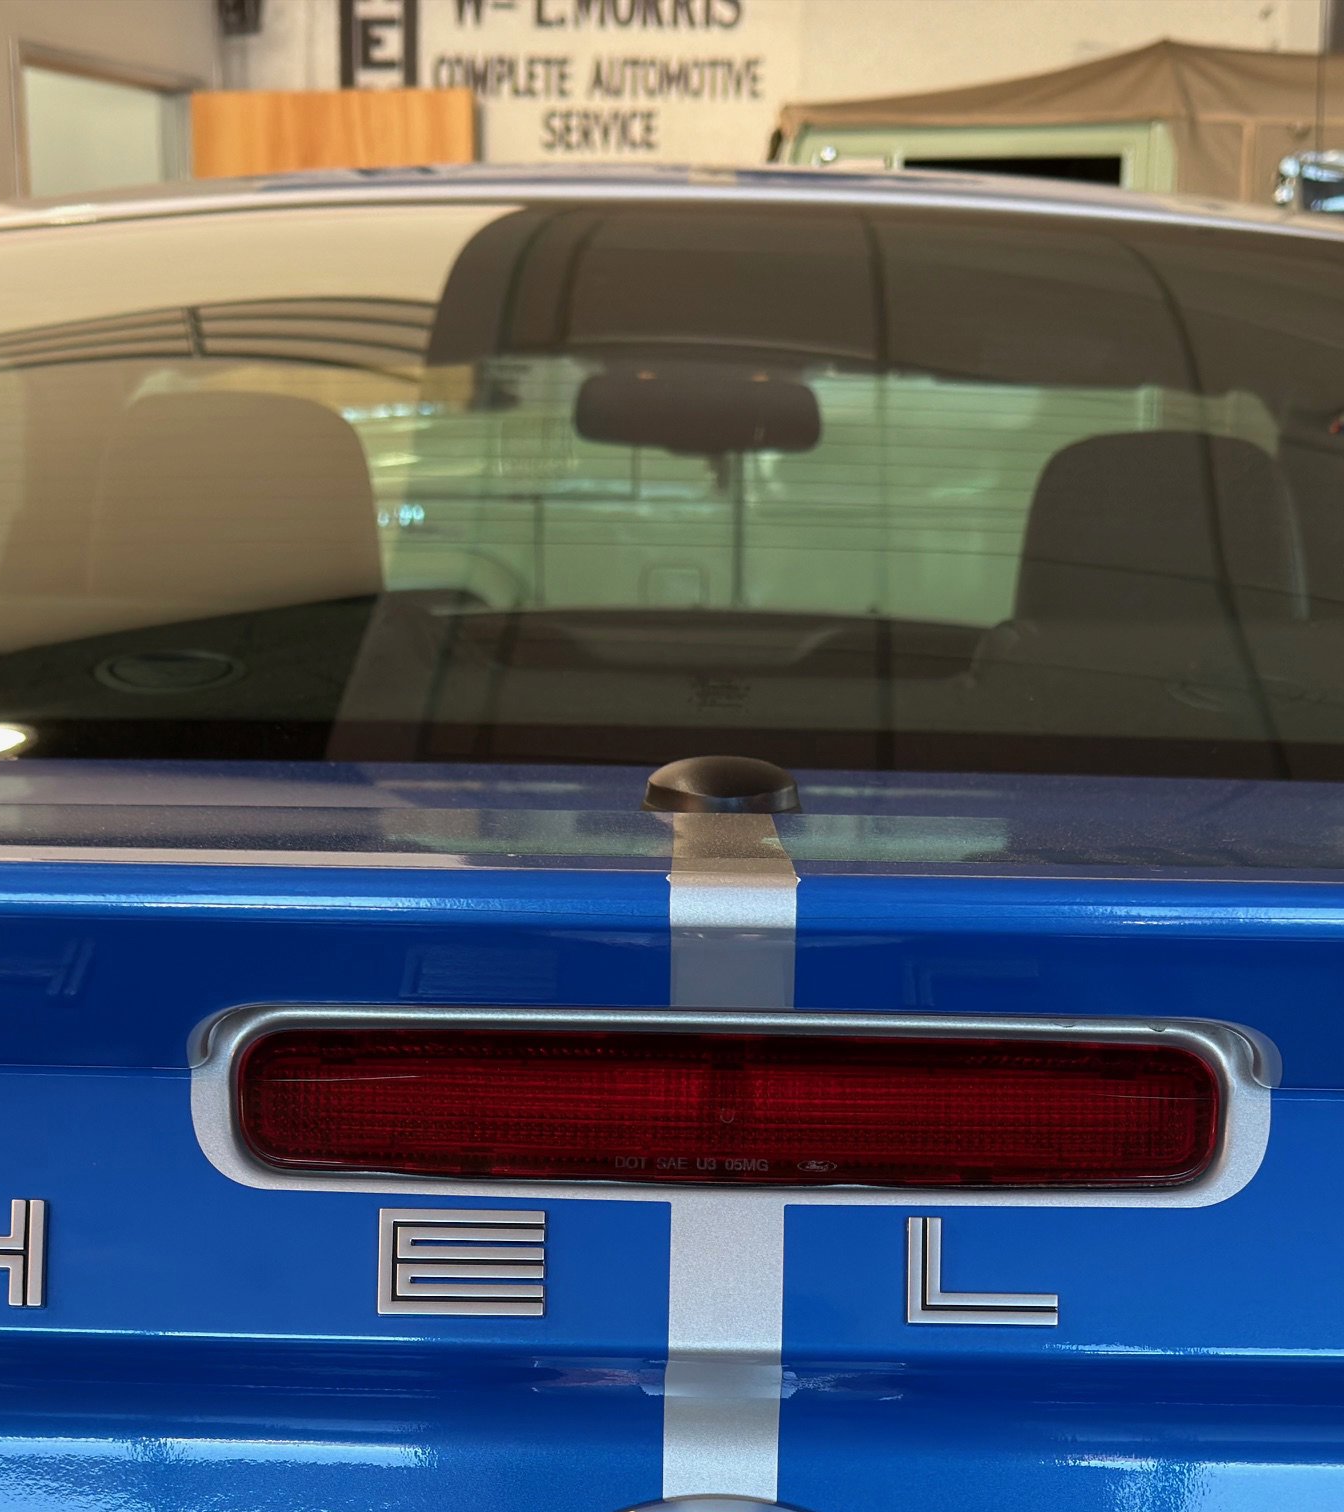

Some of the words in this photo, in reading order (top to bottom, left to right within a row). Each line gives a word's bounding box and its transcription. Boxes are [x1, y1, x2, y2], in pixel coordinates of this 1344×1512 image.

[435, 56, 572, 98] COMPLETE
[591, 56, 762, 99] AUTOMOTIVE
[543, 110, 659, 152] SERVICE
[615, 1156, 647, 1169] DOT
[657, 1157, 689, 1170] SAE
[697, 1157, 717, 1171] U3
